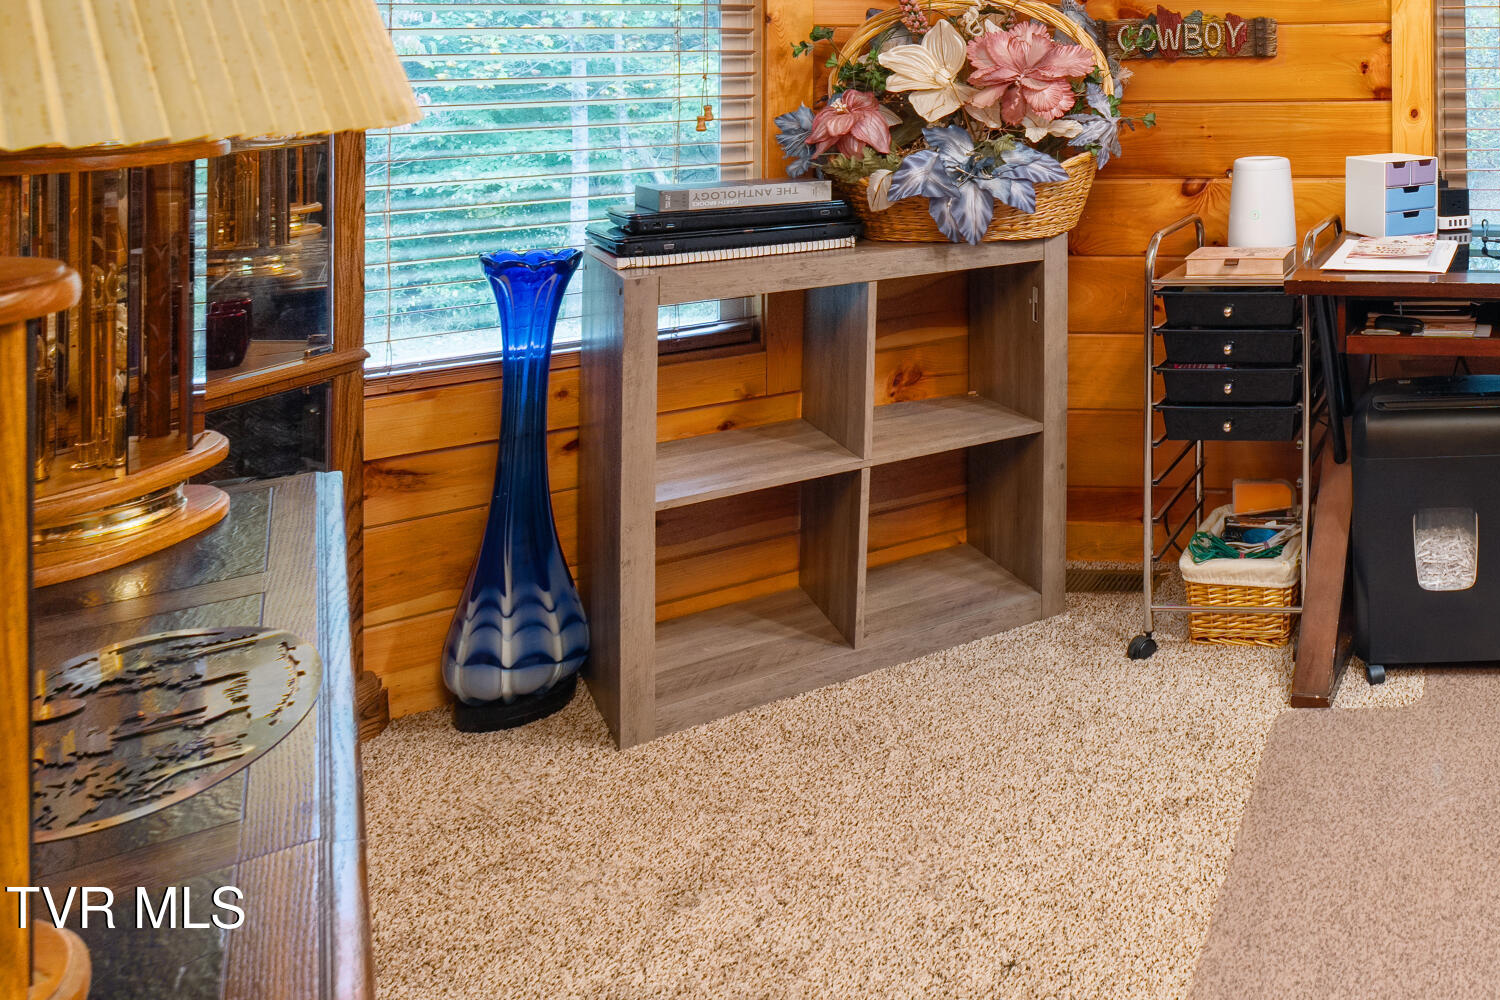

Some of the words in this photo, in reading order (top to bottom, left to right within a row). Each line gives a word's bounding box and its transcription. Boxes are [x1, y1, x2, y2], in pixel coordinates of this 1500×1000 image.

[1117, 20, 1245, 52] COWBOY
[692, 187, 773, 202] ANTHOLOGY
[776, 186, 799, 195] THE
